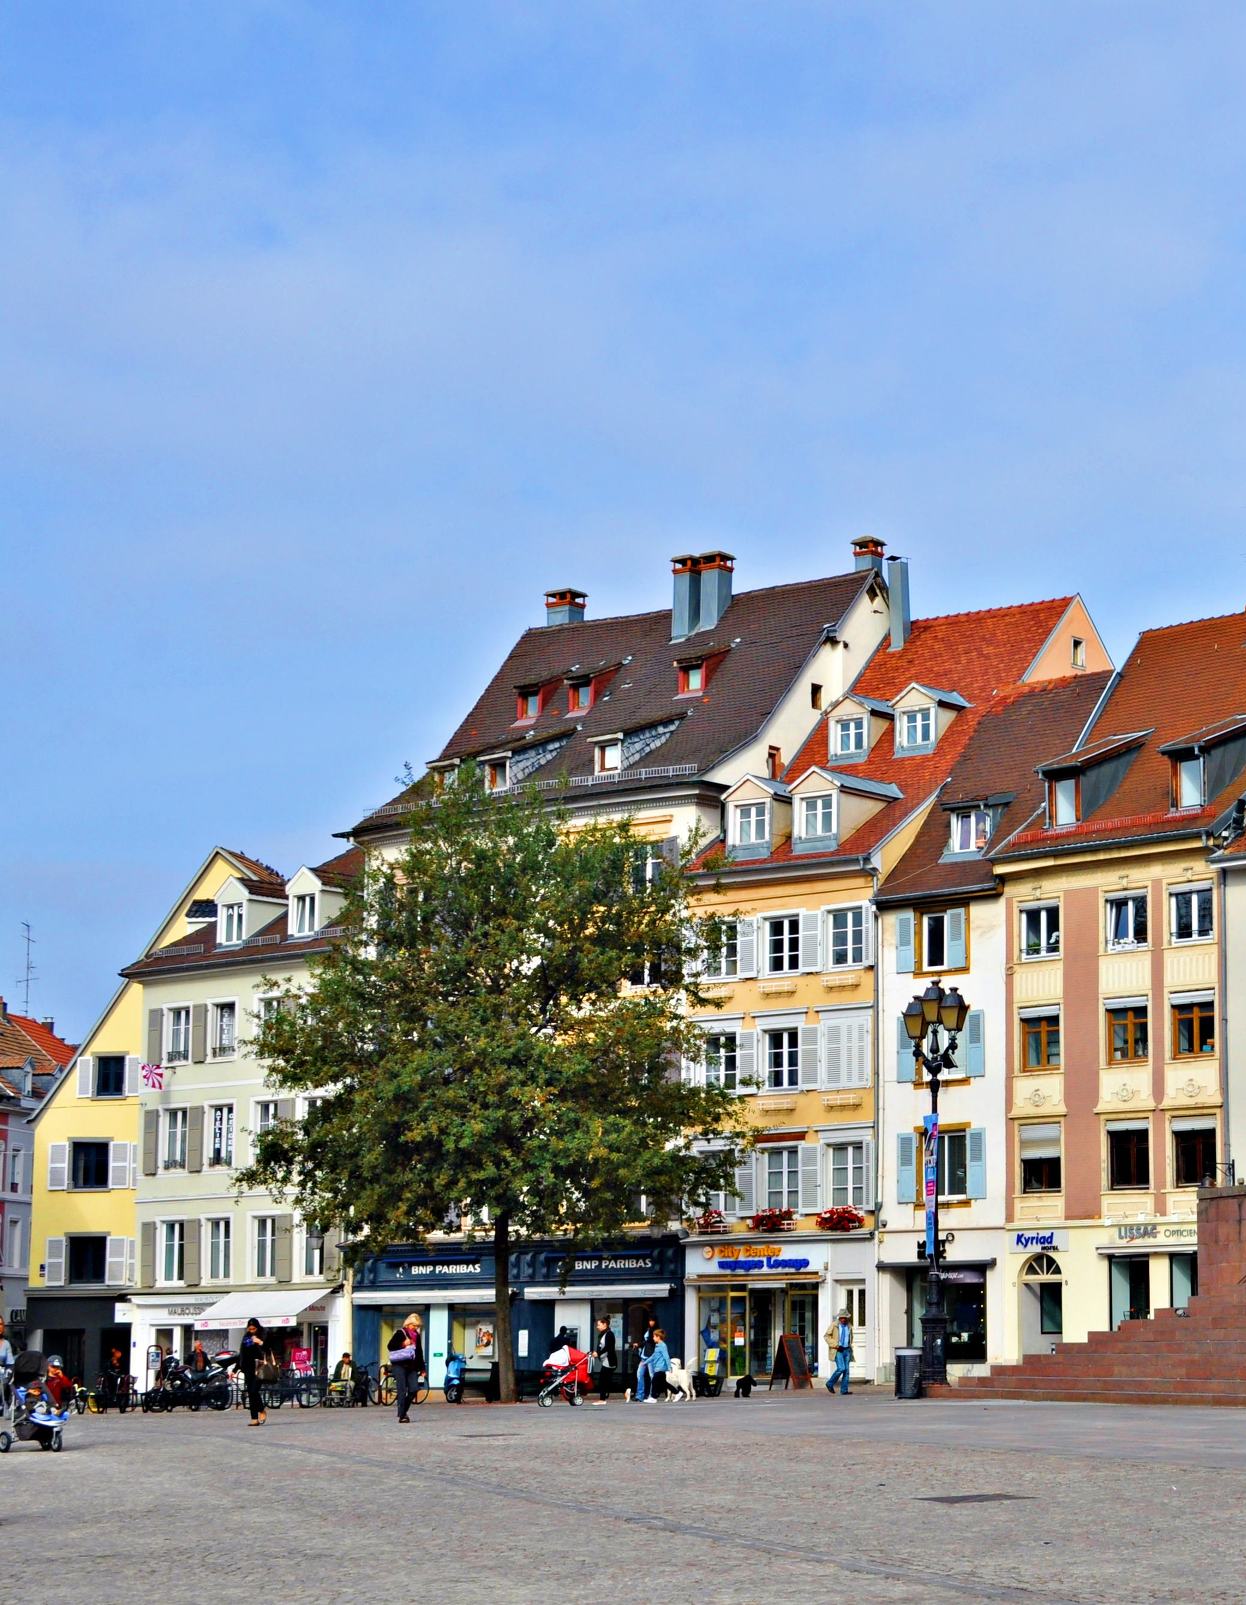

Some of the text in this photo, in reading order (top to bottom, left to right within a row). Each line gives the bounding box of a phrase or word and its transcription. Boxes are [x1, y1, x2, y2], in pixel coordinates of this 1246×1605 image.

[1016, 1232, 1054, 1249] Kyriad
[716, 1244, 782, 1259] City Center
[411, 1263, 481, 1275] BNP PARIBAS
[575, 1258, 652, 1270] BNP PARIBAS
